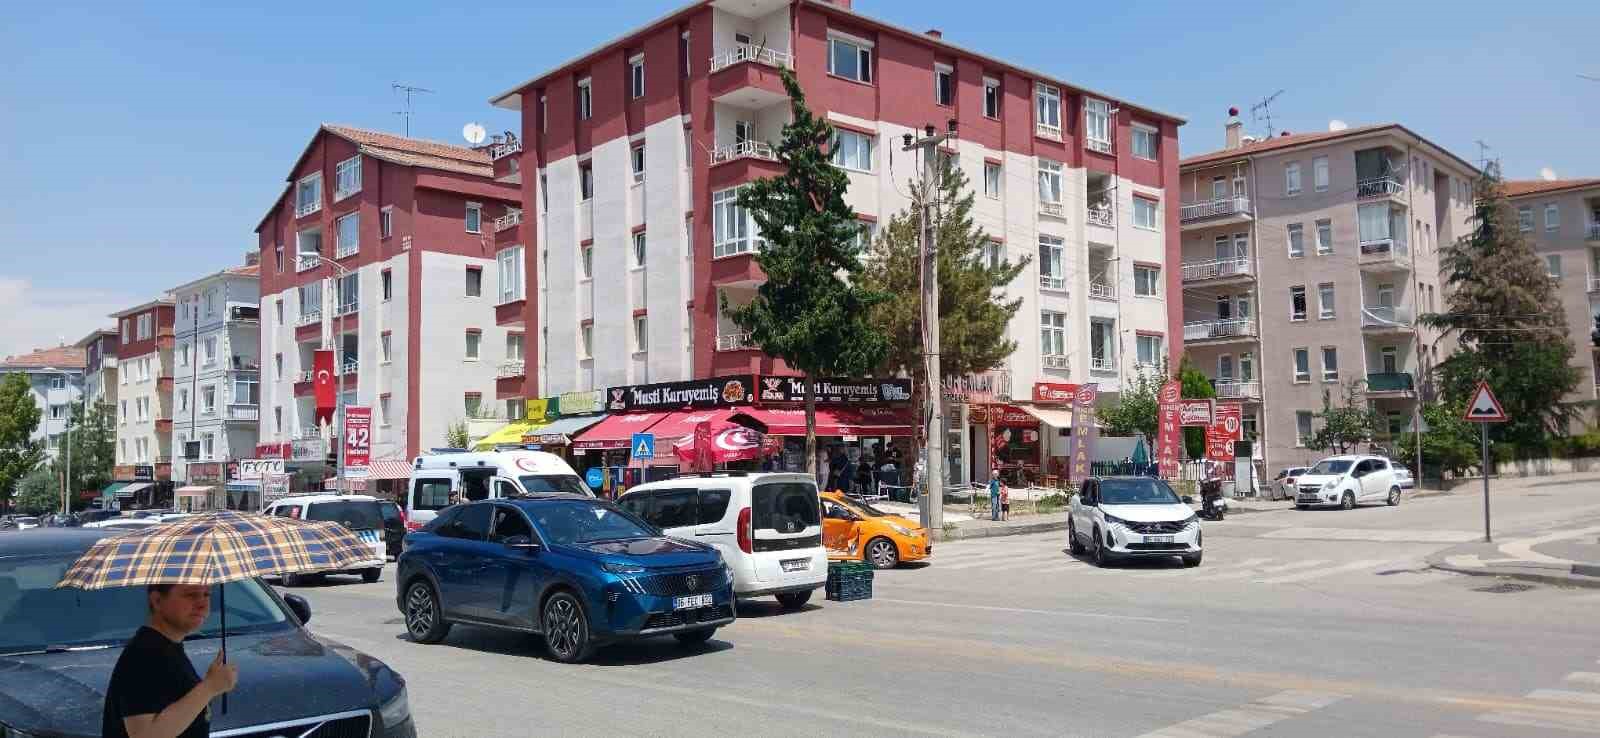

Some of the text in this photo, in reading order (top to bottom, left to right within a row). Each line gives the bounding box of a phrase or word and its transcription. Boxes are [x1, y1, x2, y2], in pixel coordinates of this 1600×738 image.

[633, 384, 719, 405] Musti Kuruyemiş
[347, 428, 369, 448] 42
